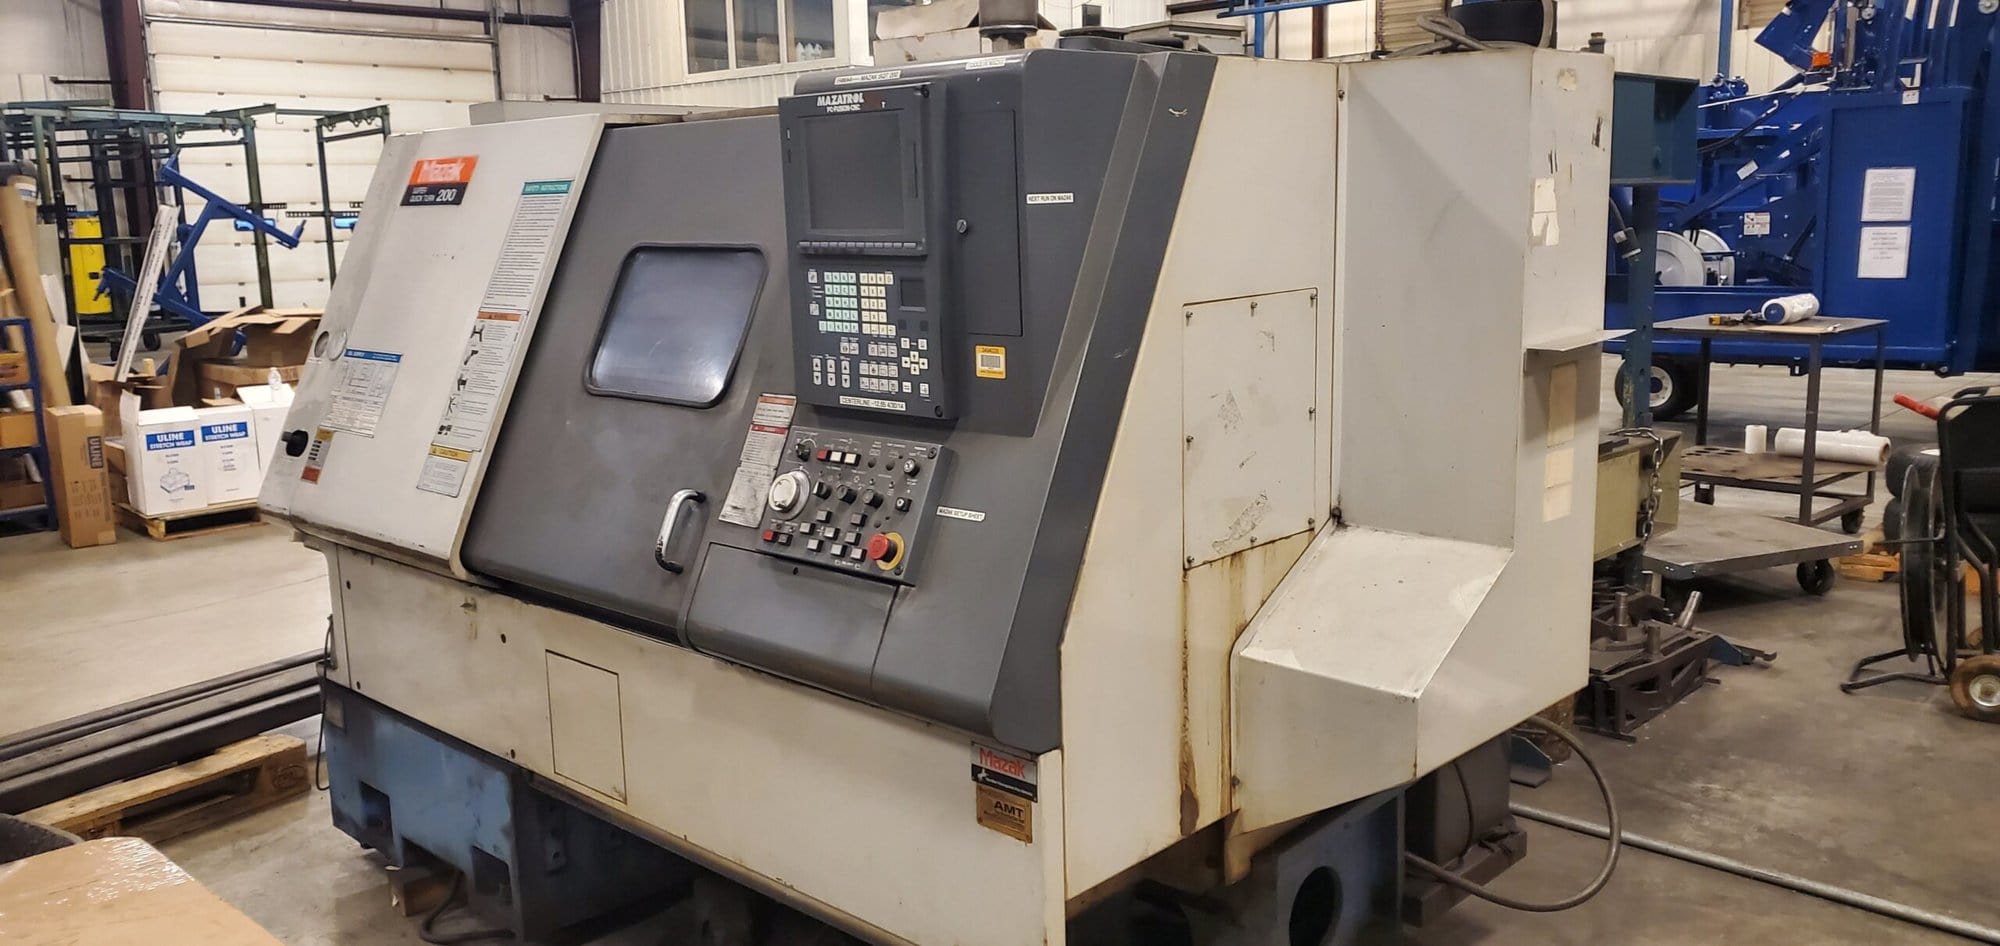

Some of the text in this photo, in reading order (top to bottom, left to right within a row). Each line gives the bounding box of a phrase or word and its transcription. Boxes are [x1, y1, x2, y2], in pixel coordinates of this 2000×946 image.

[817, 92, 864, 107] MAZATROL
[436, 189, 458, 202] 200
[211, 424, 237, 434] ULINE
[156, 432, 185, 442] ULINE
[149, 439, 193, 450] STRETCH WRAP
[89, 438, 103, 468] ULINE
[979, 748, 1025, 778] Mazak
[993, 800, 1024, 818] AMT
